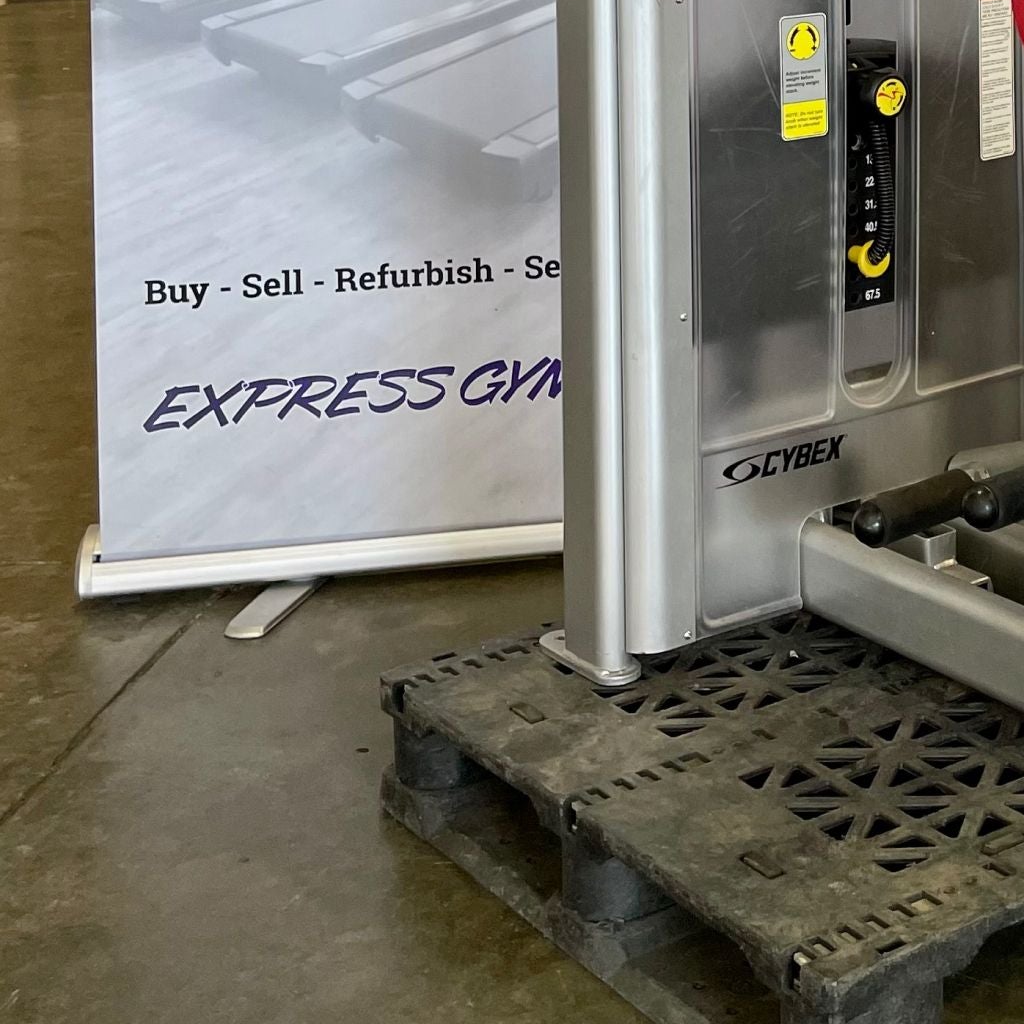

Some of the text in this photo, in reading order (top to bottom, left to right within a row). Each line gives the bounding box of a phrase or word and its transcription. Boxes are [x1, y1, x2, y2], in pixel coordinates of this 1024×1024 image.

[145, 280, 209, 309] Buy
[242, 270, 303, 298] Sell
[335, 258, 494, 293] Refurbish
[525, 255, 560, 279] Se
[865, 288, 881, 301] 67.5
[144, 365, 455, 432] EXPRESS
[760, 434, 845, 478] CYBEX
